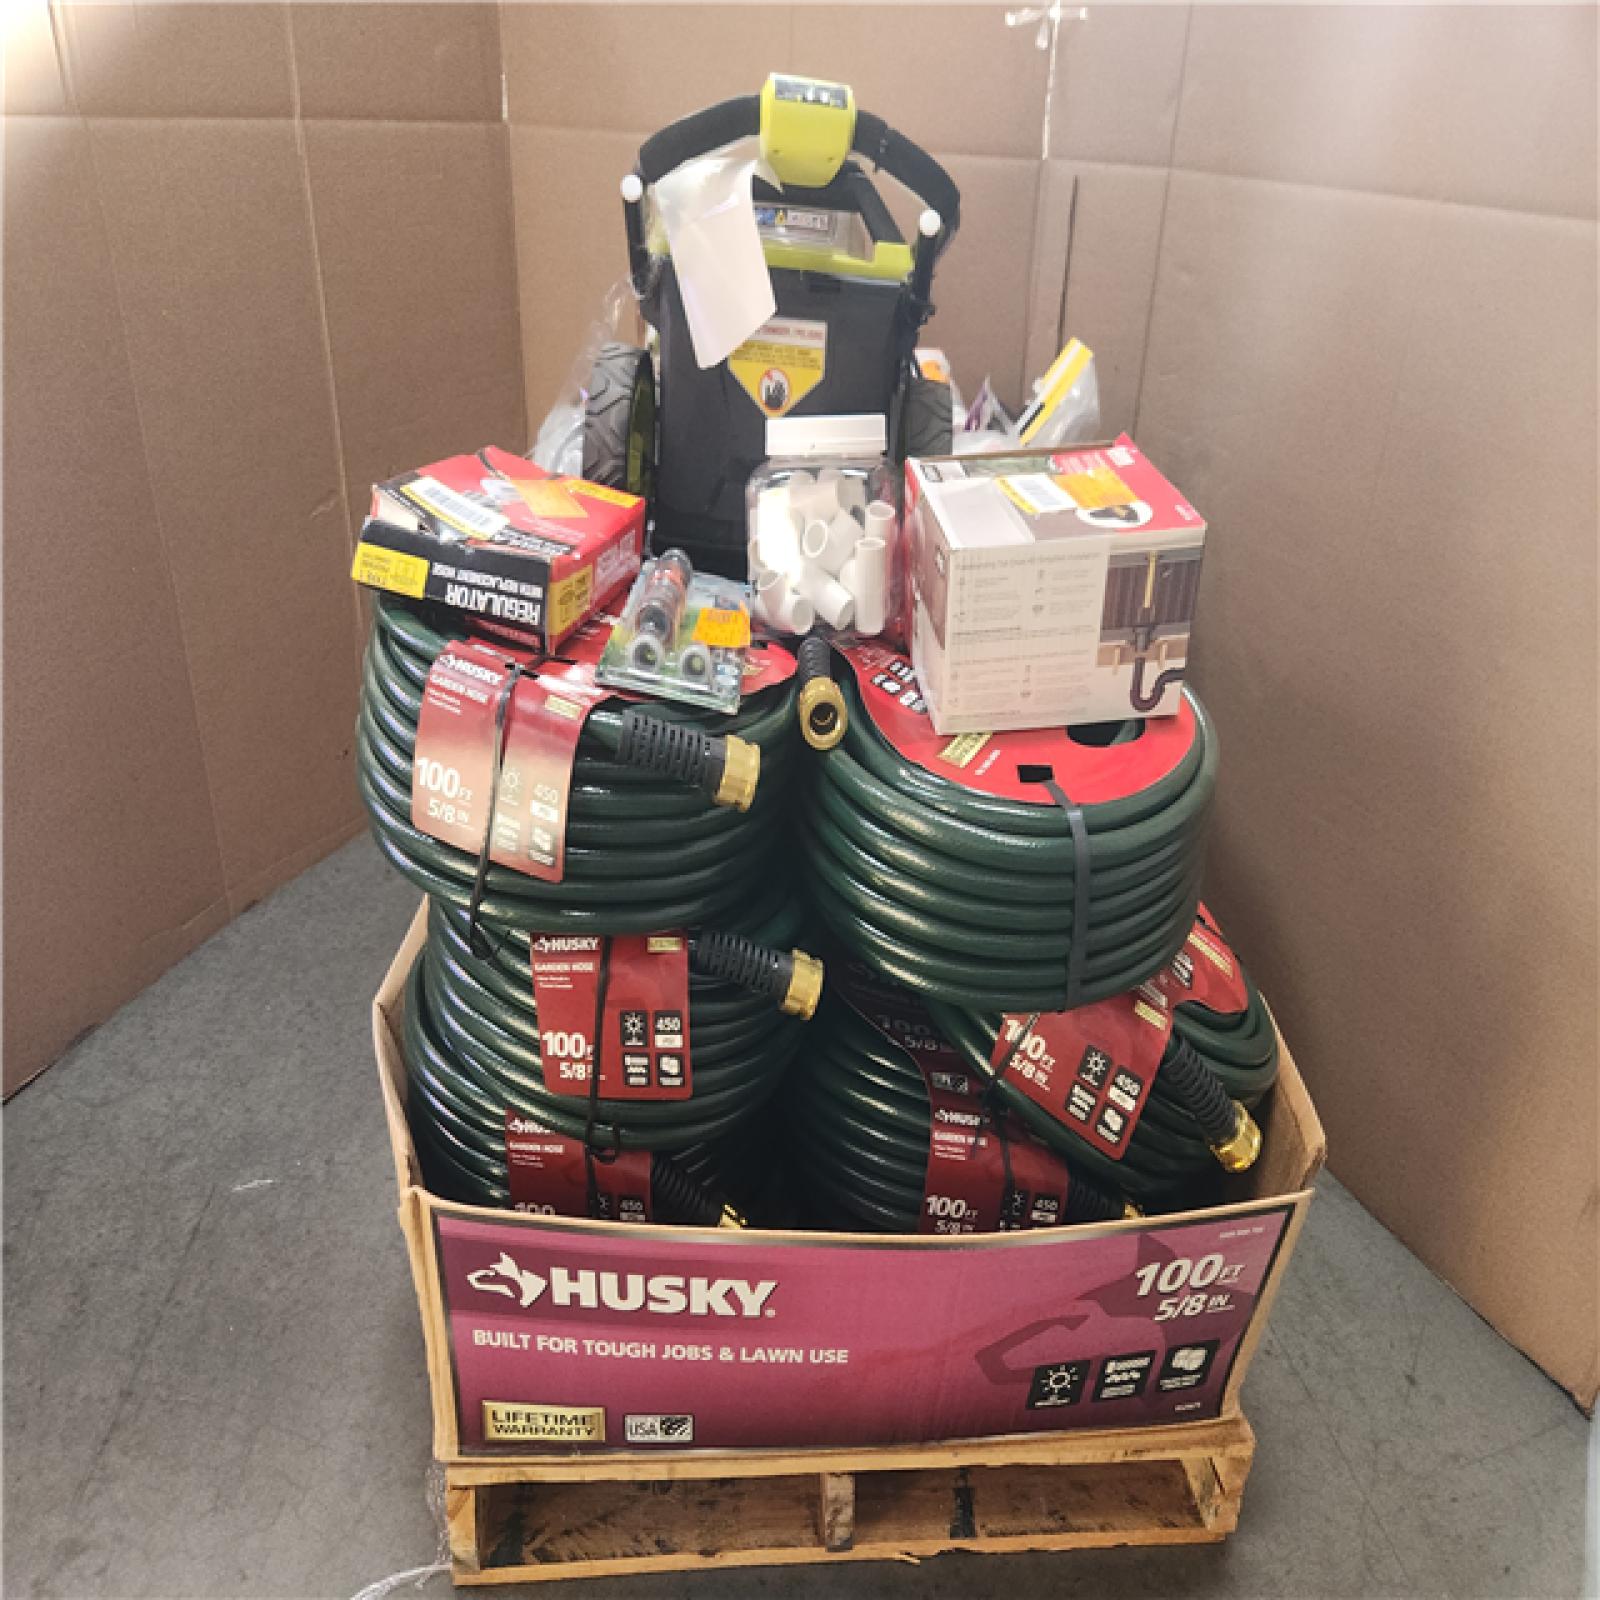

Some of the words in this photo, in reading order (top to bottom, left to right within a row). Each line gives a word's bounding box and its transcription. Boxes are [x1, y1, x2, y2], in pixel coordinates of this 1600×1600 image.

[445, 582, 541, 625] REGULATOR
[416, 757, 460, 798] 100
[428, 799, 456, 824] 5/8
[551, 937, 599, 950] HUSKY
[542, 1031, 586, 1059] 100
[559, 1062, 586, 1080] 5/8
[927, 1195, 966, 1220] 100
[1136, 1253, 1224, 1296] 100
[1219, 1264, 1246, 1280] FT
[550, 1266, 778, 1319] HUSKY
[1154, 1293, 1208, 1322] 5/8
[1208, 1294, 1232, 1307] IN
[473, 1328, 531, 1350] BUILT
[537, 1335, 578, 1355] FOR
[582, 1339, 656, 1359] TOUGH
[662, 1344, 713, 1361] JOBS
[718, 1346, 733, 1362] &
[740, 1347, 803, 1364] LAWN
[810, 1349, 849, 1364] USE
[491, 1408, 595, 1427] LIFETIME
[492, 1424, 595, 1436] WARRANTY
[629, 1420, 658, 1436] USA
